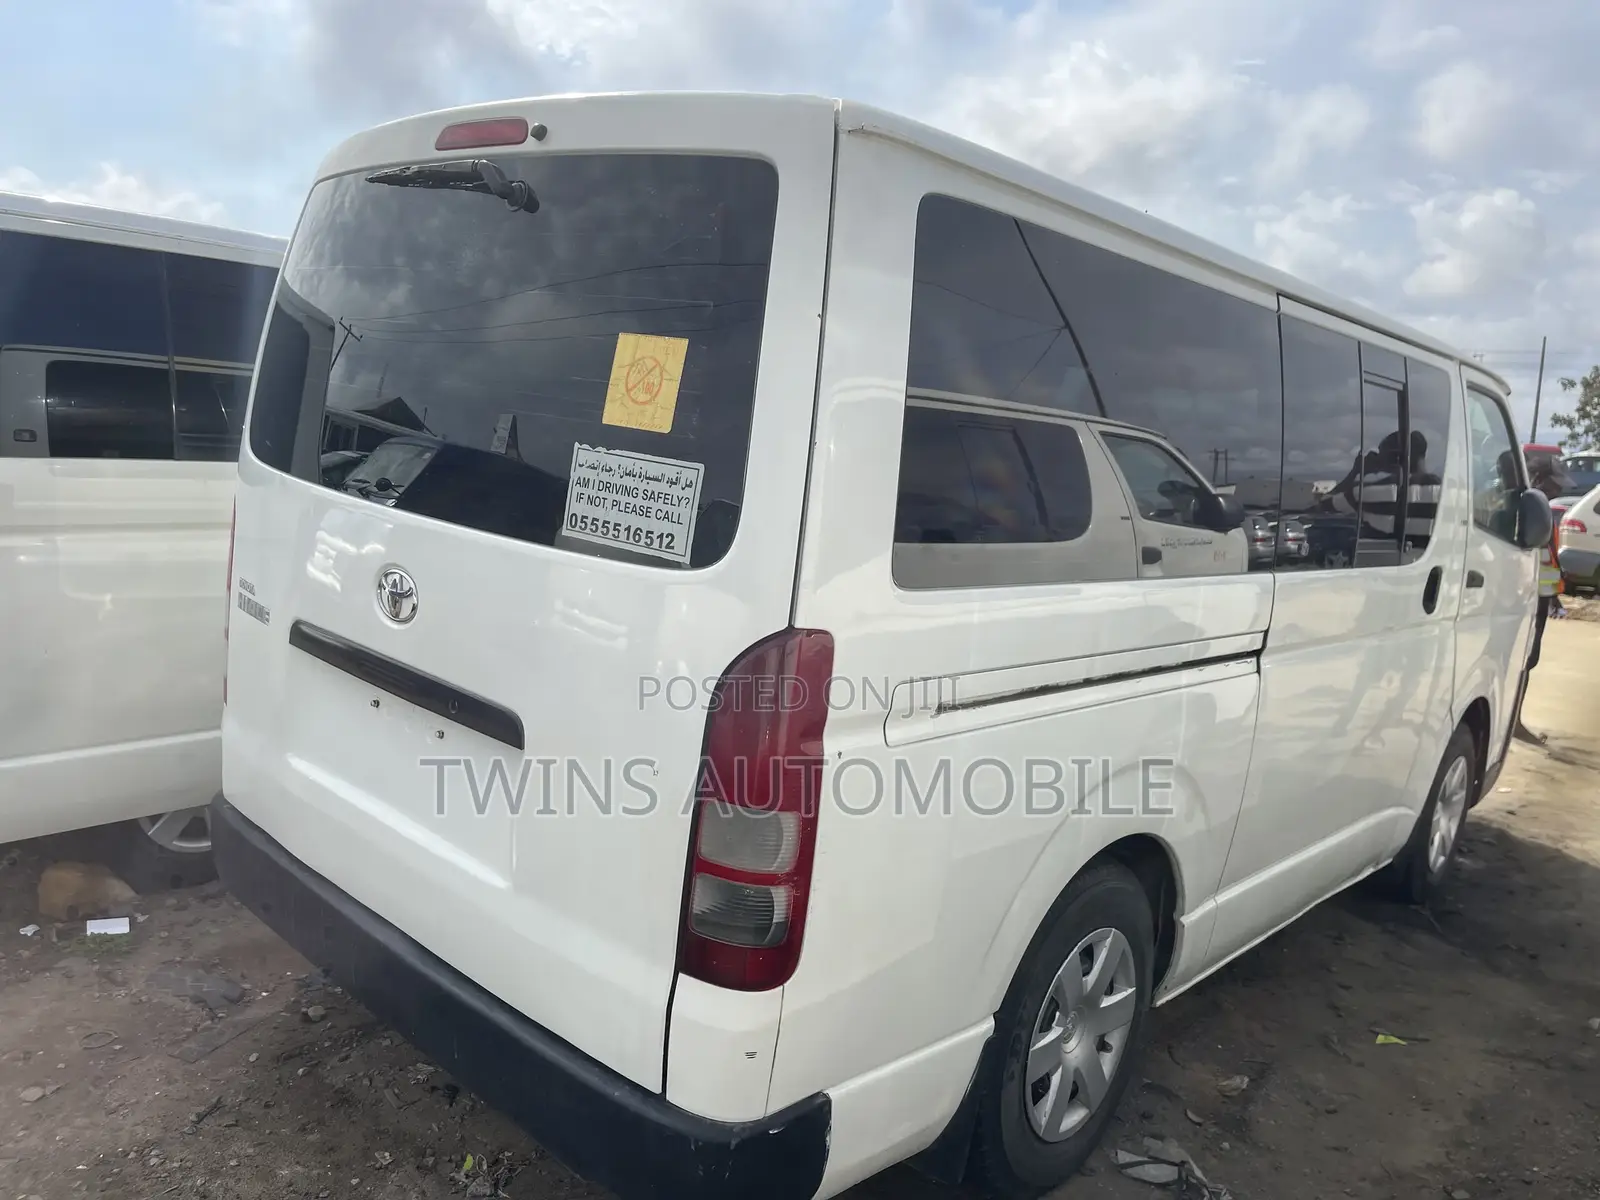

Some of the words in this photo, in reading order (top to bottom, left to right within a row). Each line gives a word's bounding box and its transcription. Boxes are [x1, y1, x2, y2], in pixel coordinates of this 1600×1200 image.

[637, 466, 665, 485] السيارة
[681, 477, 693, 490] هل
[574, 476, 590, 489] AM
[591, 480, 595, 490] I
[597, 480, 639, 499] DRIVING
[641, 488, 690, 509] SAFELY?
[575, 492, 585, 503] IF
[586, 495, 608, 511] NOT,
[611, 500, 652, 518] PLEASE
[655, 508, 683, 525] CALL
[569, 512, 675, 550] 0555516512
